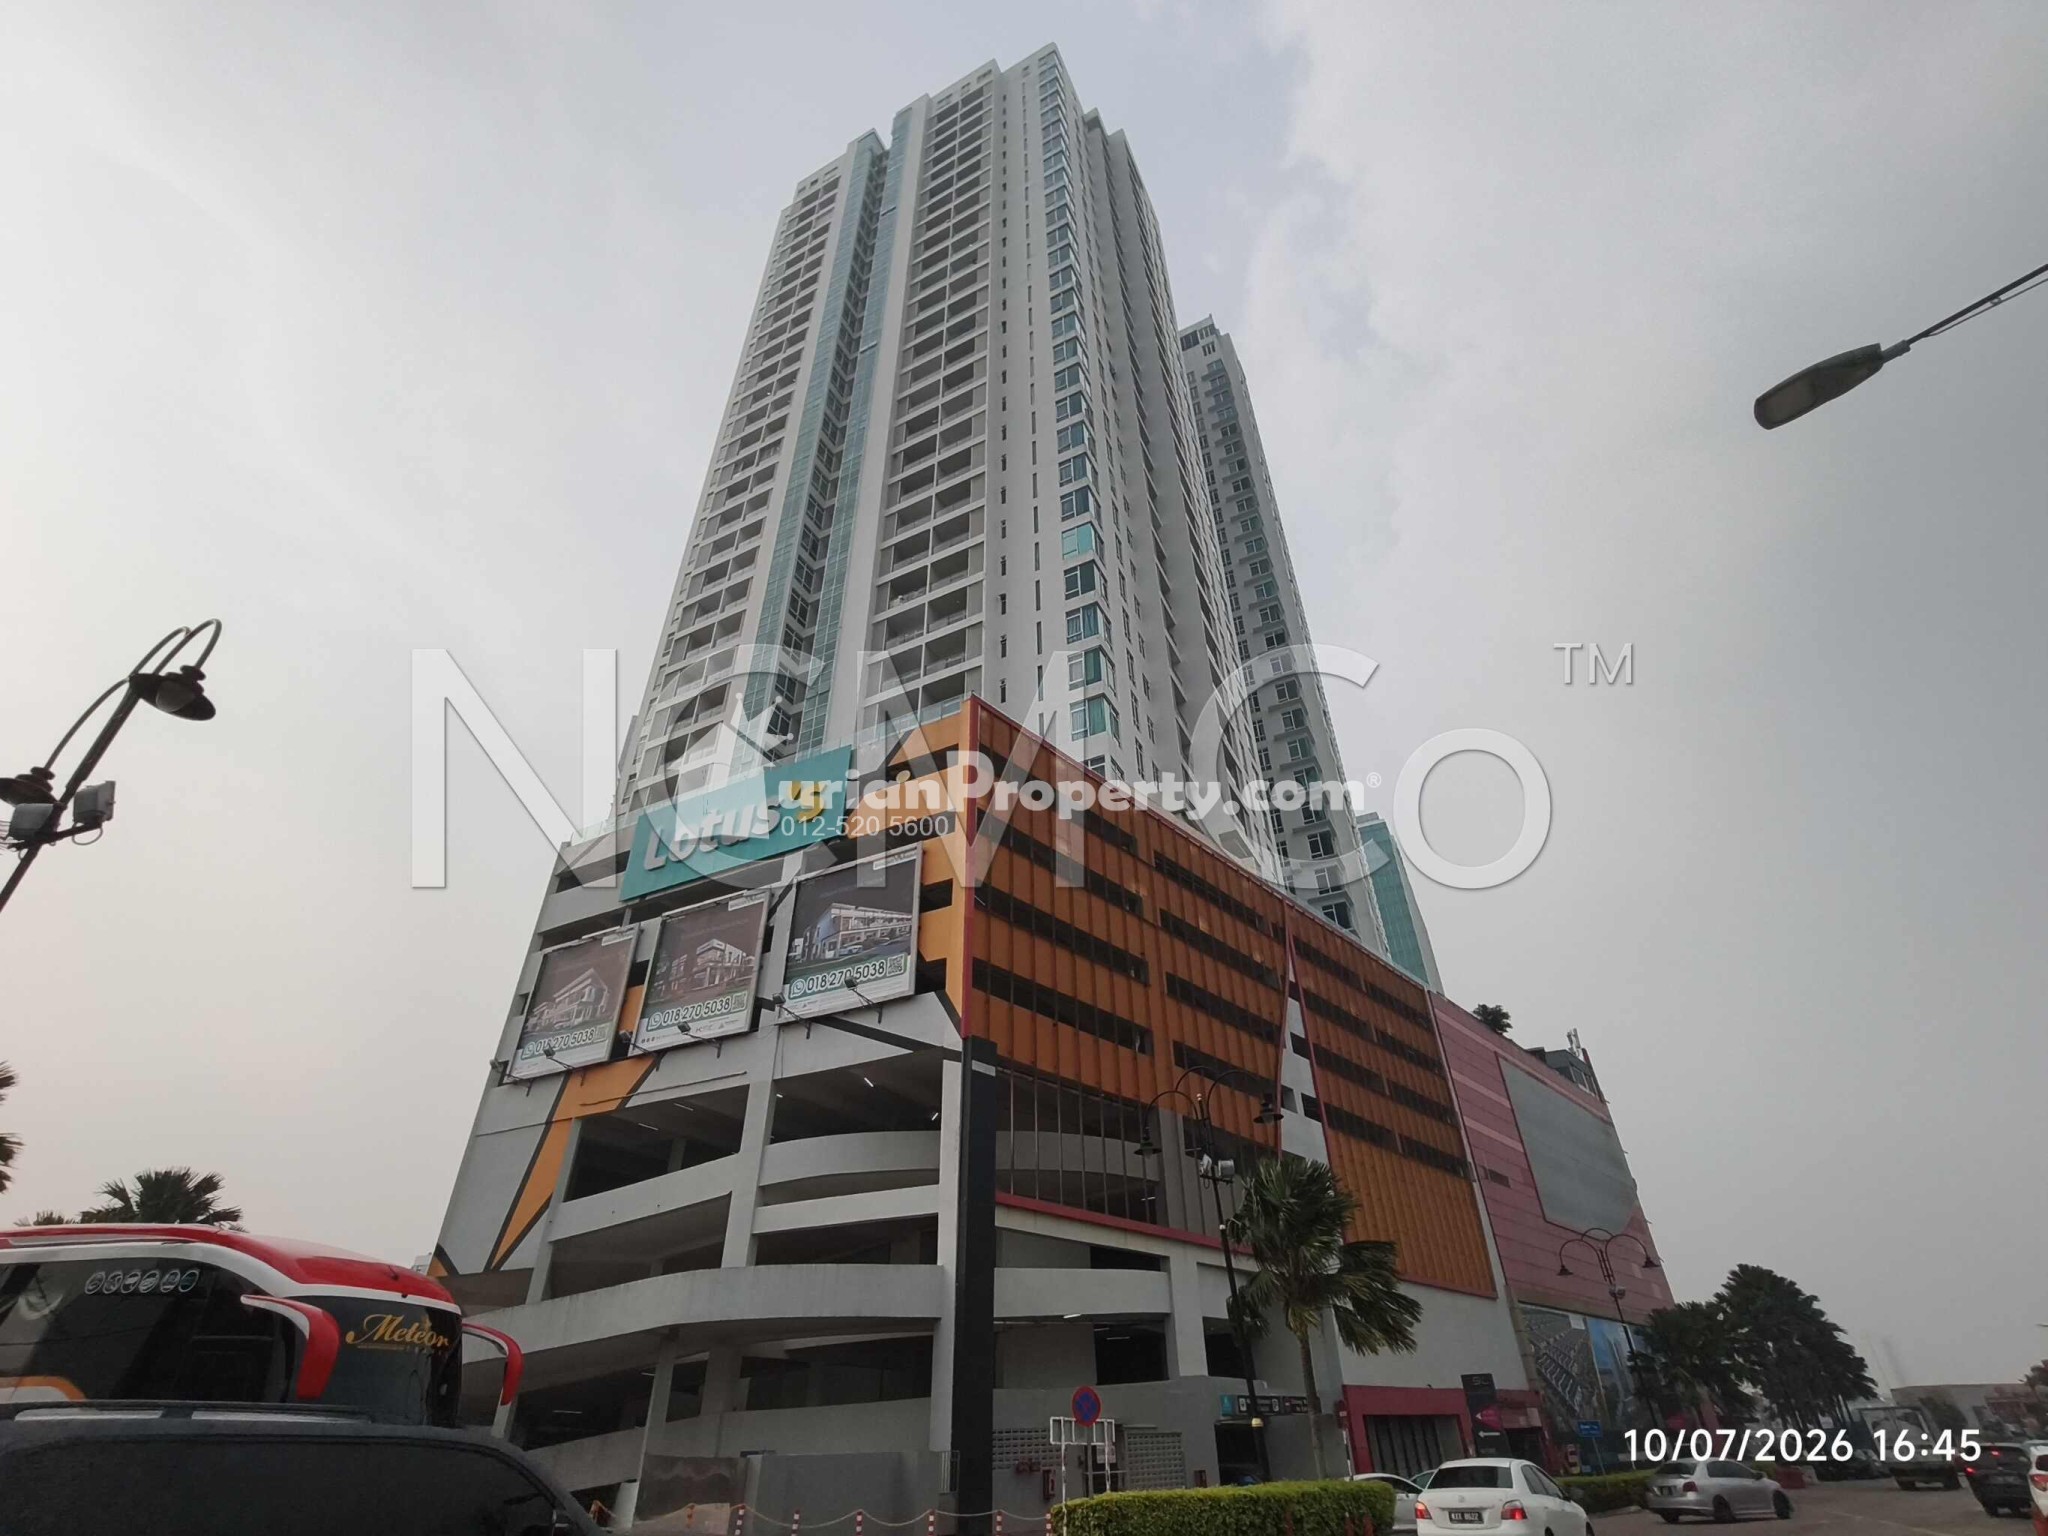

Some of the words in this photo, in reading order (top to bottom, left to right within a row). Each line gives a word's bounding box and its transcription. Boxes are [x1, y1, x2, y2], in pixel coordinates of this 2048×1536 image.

[807, 974, 828, 991] 018
[829, 969, 852, 986] 270
[855, 961, 886, 979] 5038
[662, 1010, 682, 1025] 018
[682, 1004, 702, 1020] 270
[703, 998, 731, 1015] 5038
[553, 1034, 571, 1048] 270
[571, 1029, 595, 1045] 5038
[345, 1314, 449, 1347] Meteor
